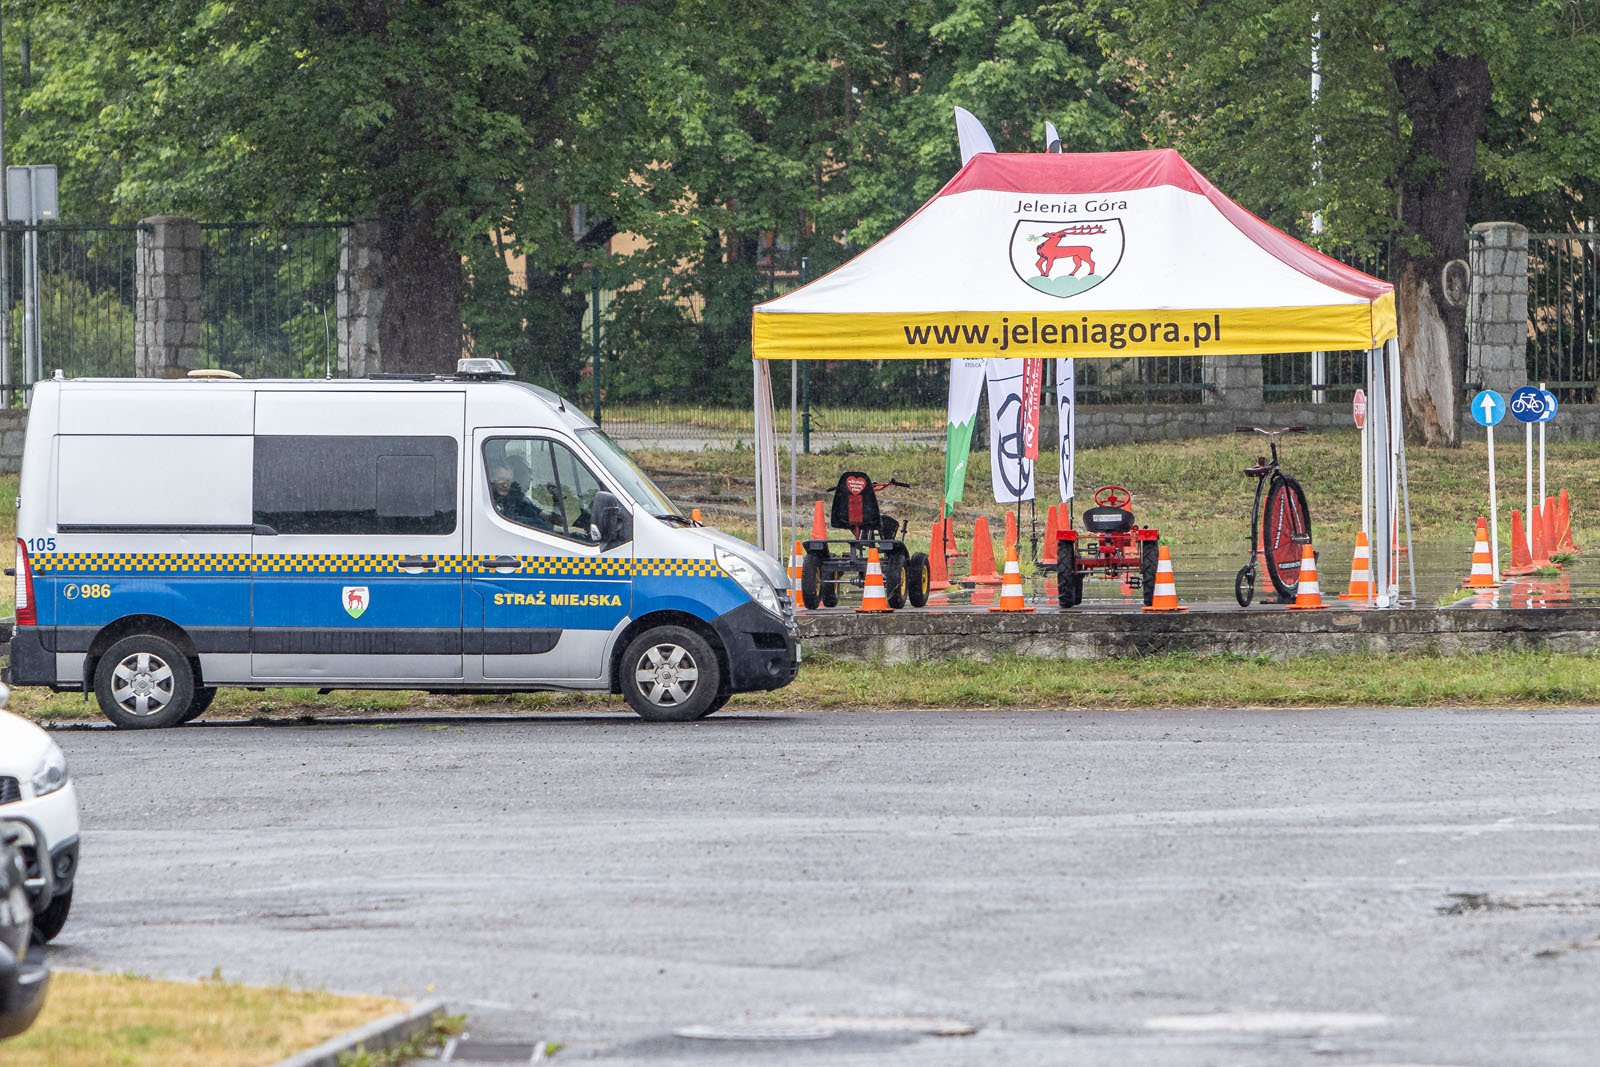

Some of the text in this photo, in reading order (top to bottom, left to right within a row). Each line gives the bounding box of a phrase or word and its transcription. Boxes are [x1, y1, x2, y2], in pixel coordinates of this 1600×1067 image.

[1014, 199, 1128, 214] Jelenia Góra
[903, 314, 1221, 350] www.jeleniagora.pl
[27, 537, 57, 552] 105
[80, 583, 112, 599] 986
[493, 590, 622, 607] STRAŻ MIEJSKA
